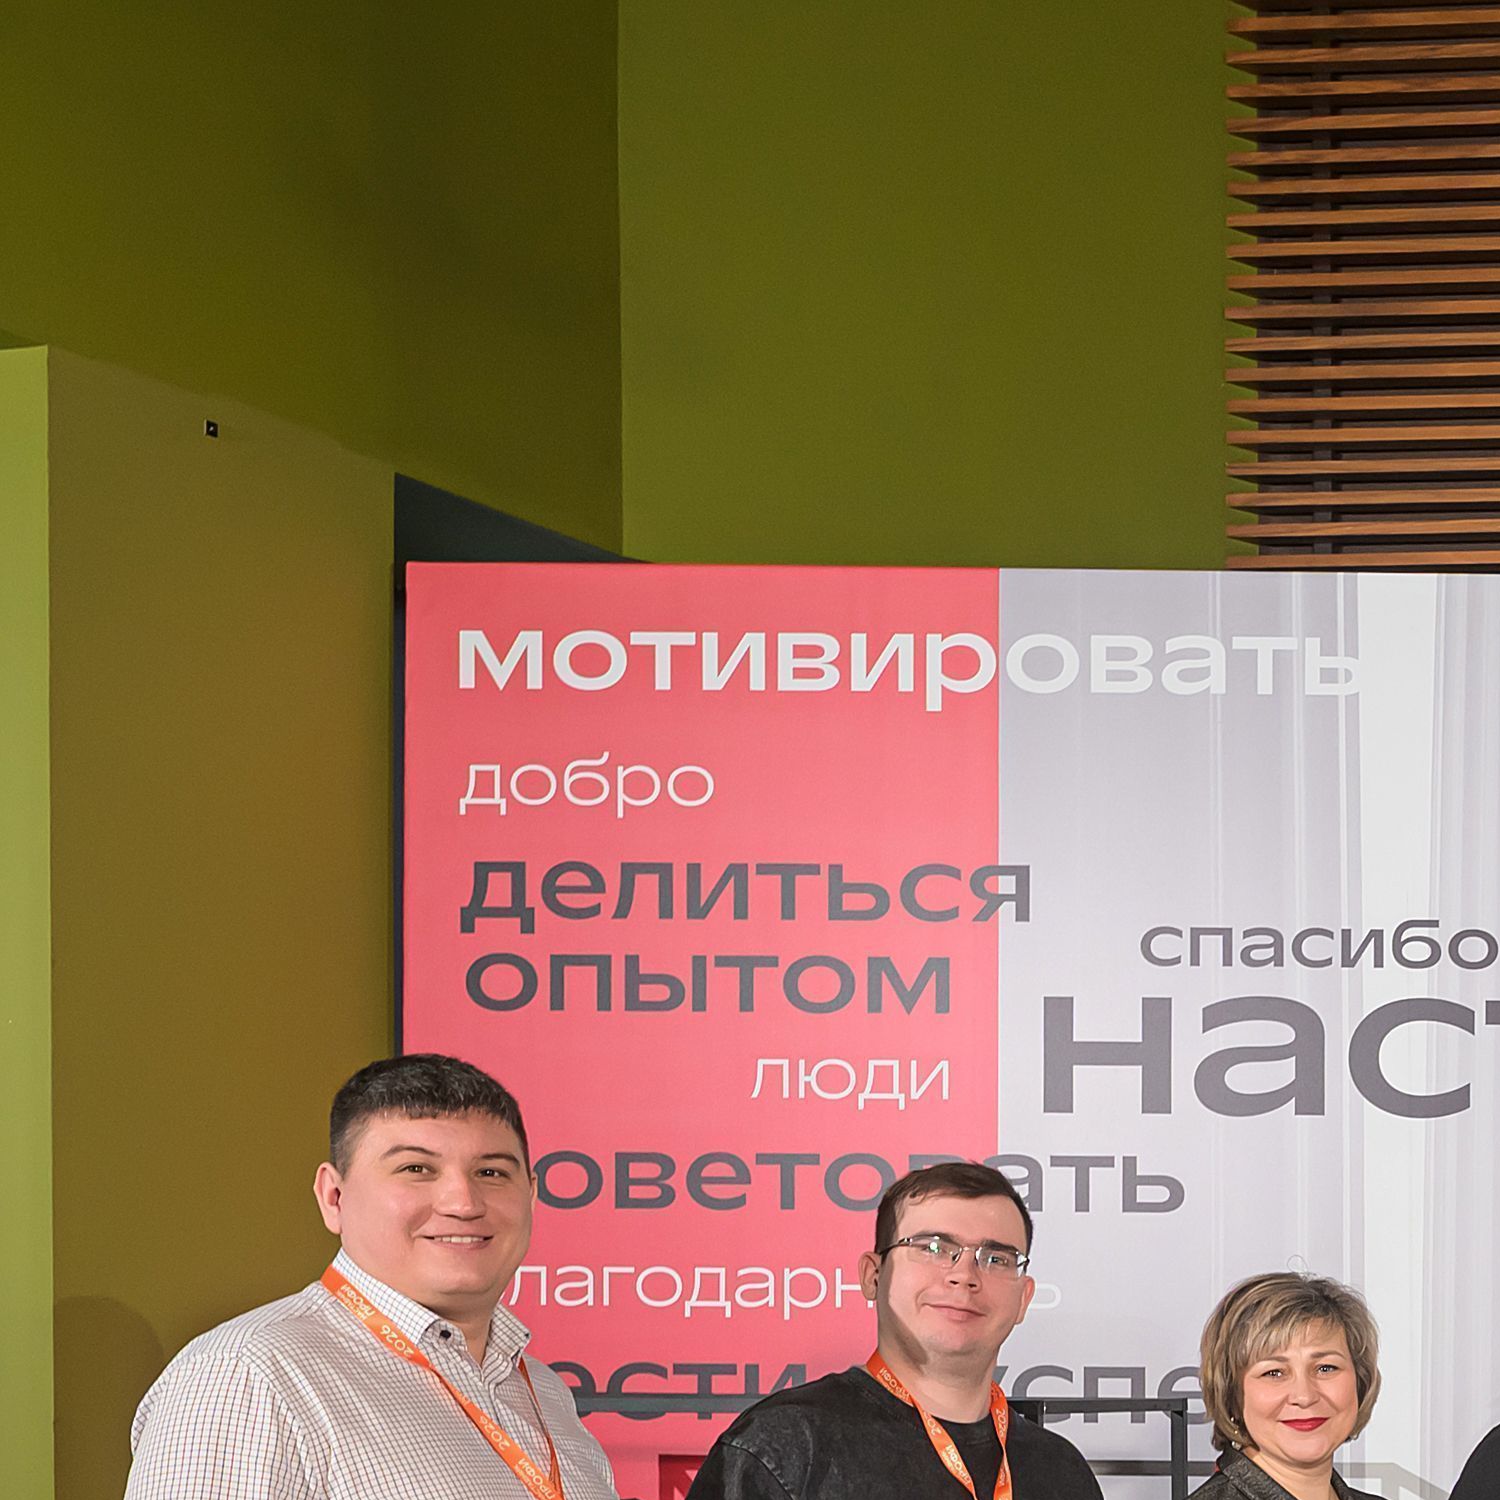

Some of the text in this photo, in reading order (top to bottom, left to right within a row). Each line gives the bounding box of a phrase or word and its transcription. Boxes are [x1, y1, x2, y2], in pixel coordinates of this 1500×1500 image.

[458, 629, 1360, 711] мотивировать
[460, 752, 714, 817] добро
[460, 860, 1031, 934] делиться
[1138, 918, 1498, 970] спасибо
[464, 953, 950, 1015] опытом
[750, 1058, 950, 1112] люди
[380, 1324, 415, 1358] 2026
[479, 1415, 510, 1451] 2026
